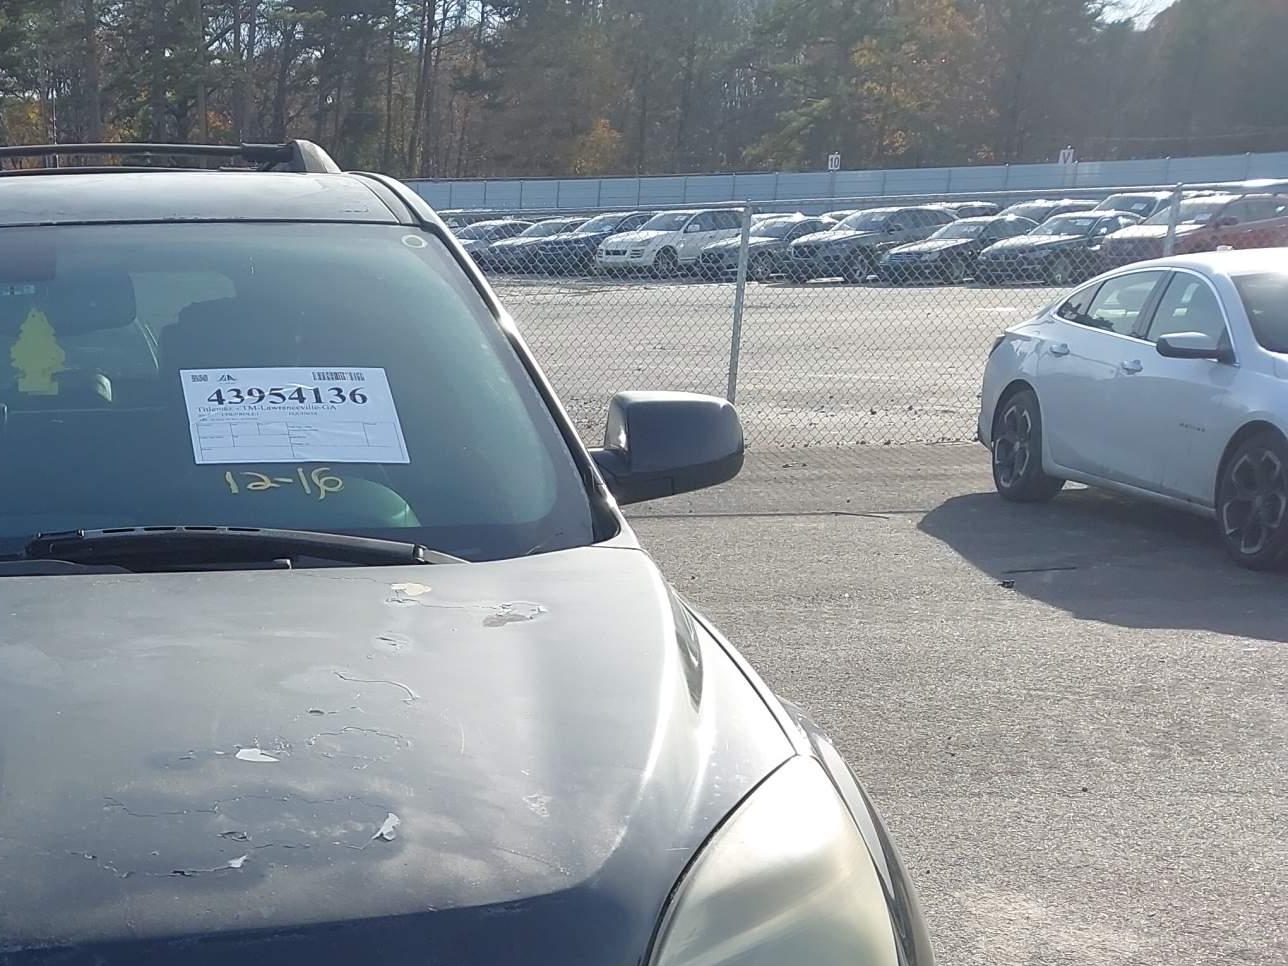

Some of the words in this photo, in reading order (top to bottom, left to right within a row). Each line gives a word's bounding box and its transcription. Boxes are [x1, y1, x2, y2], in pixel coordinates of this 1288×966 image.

[830, 157, 840, 169] 10
[207, 386, 368, 405] 43954136
[224, 467, 344, 500] 12-16
